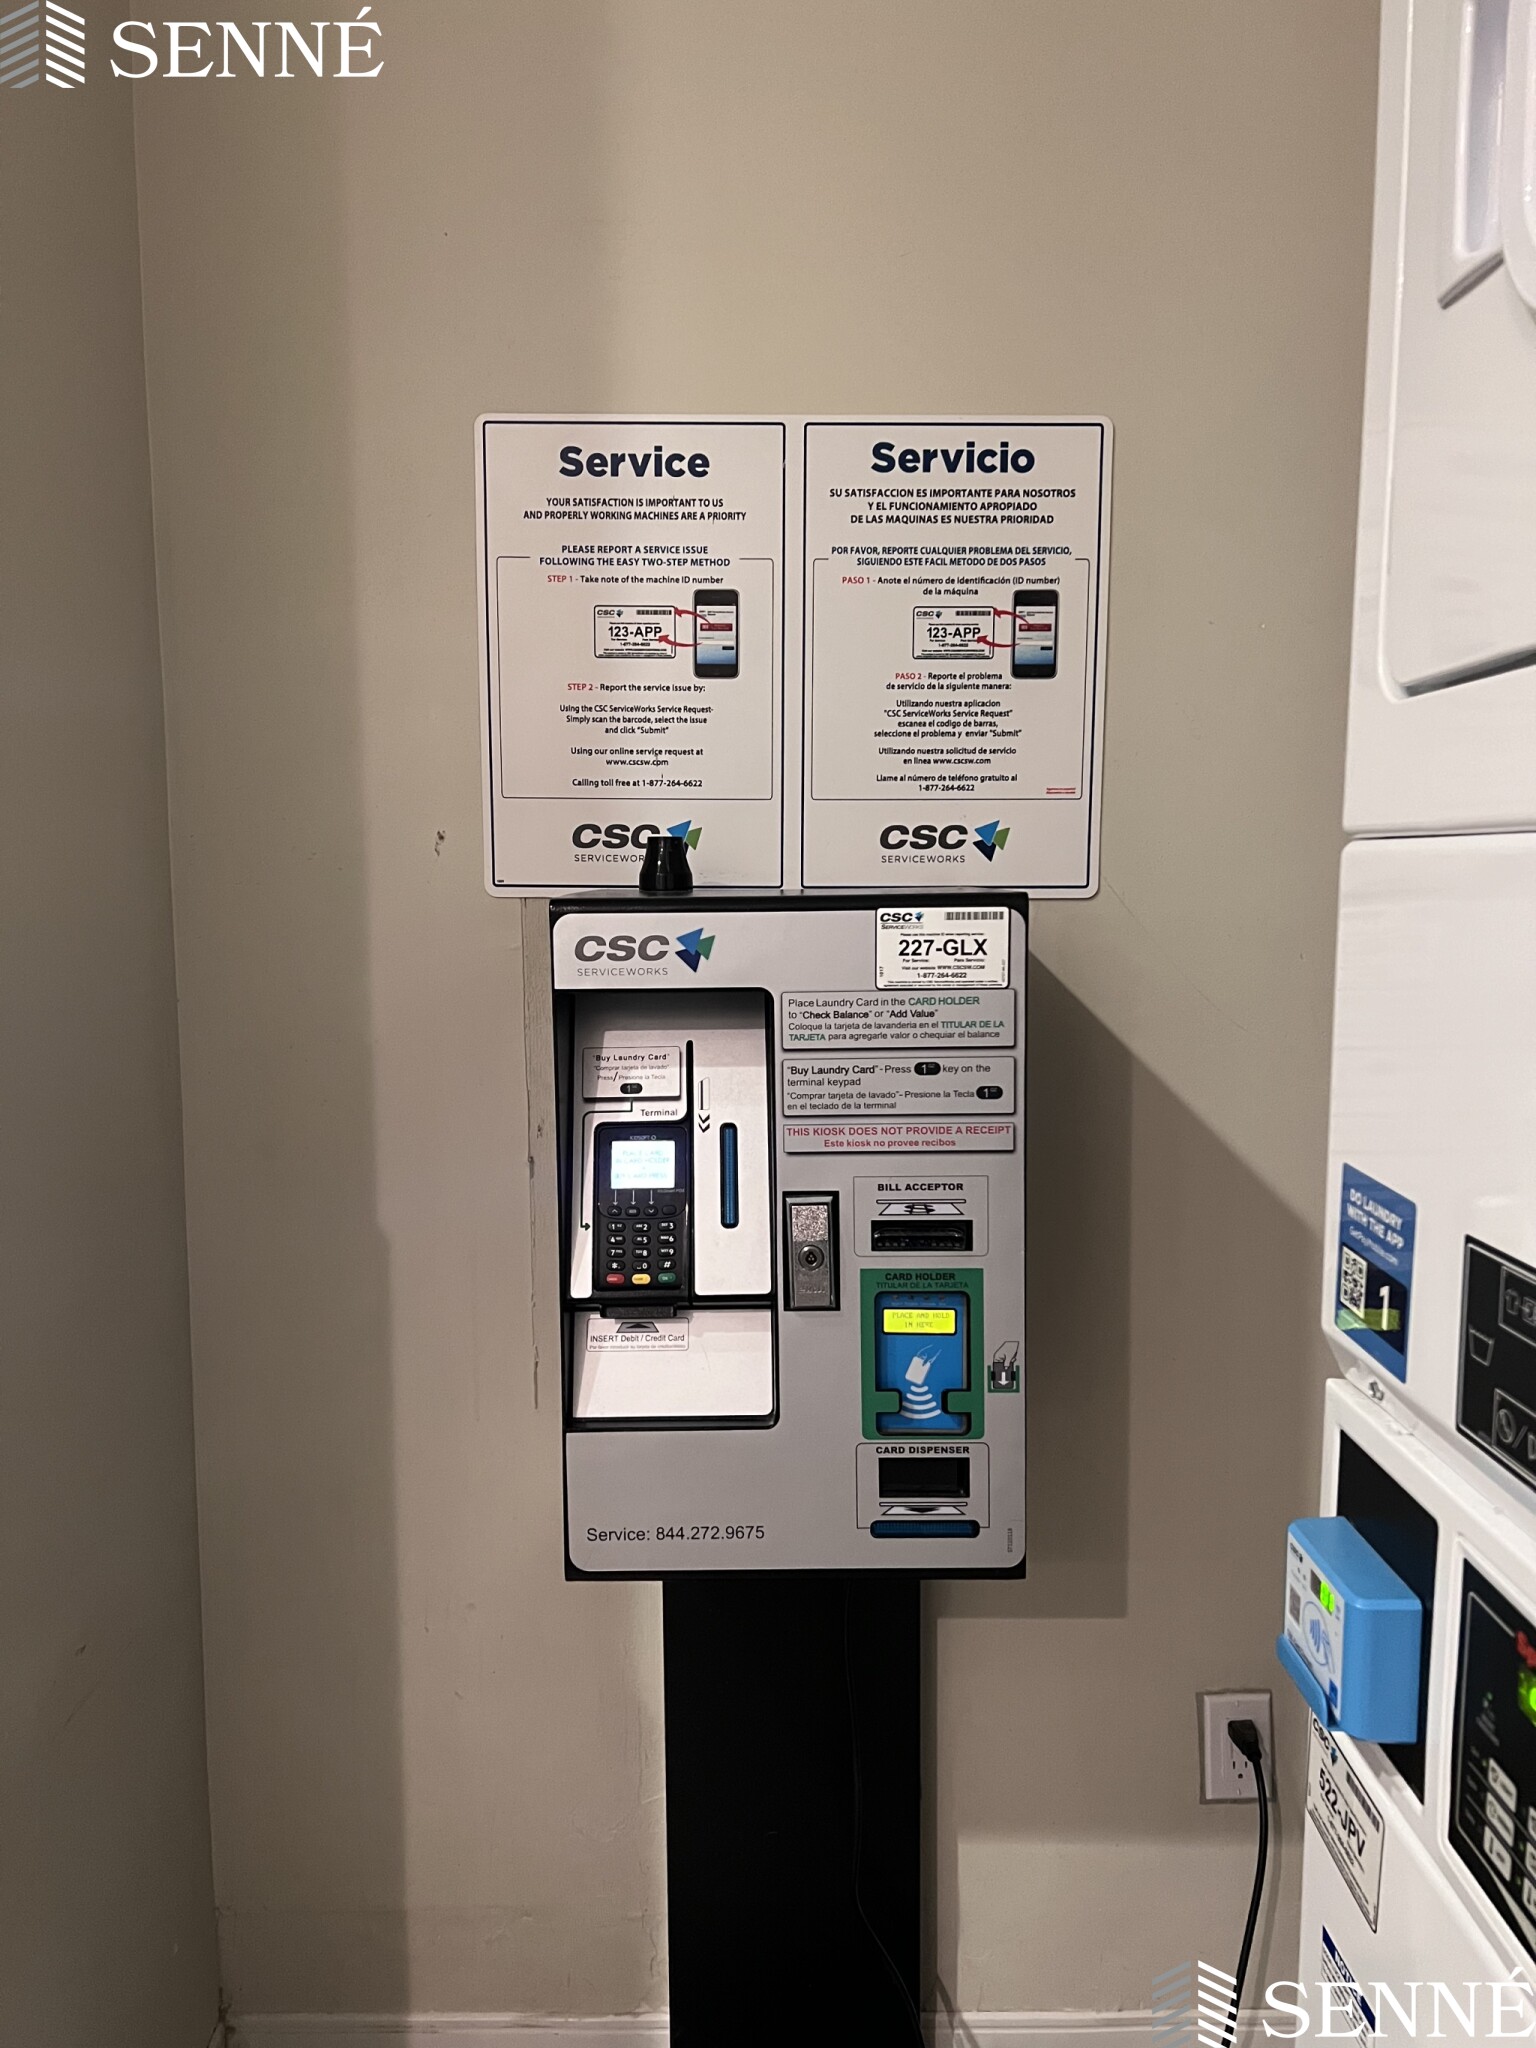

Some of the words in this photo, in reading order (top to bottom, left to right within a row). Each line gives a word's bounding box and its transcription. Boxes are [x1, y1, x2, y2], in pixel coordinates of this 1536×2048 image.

[560, 446, 708, 478] Service
[871, 441, 1034, 473] Servicio
[829, 488, 842, 497] SU
[844, 488, 913, 498] SATISFACCION
[916, 488, 927, 497] ES
[929, 488, 992, 498] IMPORTANTE
[994, 488, 1020, 497] PARA
[1022, 488, 1075, 498] NOSOTROS
[546, 497, 570, 506] YOUR
[572, 497, 633, 507] SATISFACTION
[635, 498, 643, 507] IS
[645, 497, 696, 507] IMPORTANT
[697, 498, 710, 507] TO
[711, 497, 723, 507] US
[867, 502, 874, 510] Y
[876, 502, 887, 510] EL
[889, 502, 977, 510] FUNCIONAMIENTO
[979, 502, 1037, 510] APROPIADO
[523, 510, 542, 519] AND
[544, 510, 588, 519] PROPERLY
[590, 510, 632, 520] WORKING
[633, 511, 679, 520] MACHINES
[680, 511, 697, 520] ARE
[699, 511, 705, 520] A
[707, 511, 746, 521] PRIORITY
[850, 514, 863, 524] DE
[865, 514, 883, 523] LAS
[885, 514, 938, 525] MAQUINAS
[940, 514, 951, 524] ES
[954, 514, 998, 524] NUESTRA
[1000, 514, 1054, 524] PRIORIDAD
[561, 545, 595, 553] PLEASE
[597, 545, 632, 554] REPORT
[634, 545, 641, 554] A
[643, 545, 680, 554] SERVICE
[682, 545, 708, 554] ISSUE
[831, 546, 848, 554] POR
[850, 546, 880, 555] FAVOR,
[881, 546, 918, 555] REPORTE
[919, 546, 966, 555] CUALQUIER
[968, 546, 1013, 555] PROBLEMA
[1014, 546, 1030, 555] DEL
[1032, 546, 1072, 555] SERVICIO,
[539, 557, 594, 565] FOLLOWING
[596, 557, 614, 566] THE
[616, 557, 639, 566] EASY
[641, 557, 688, 566] TWO-STEP
[690, 557, 730, 566] METHOD
[547, 574, 566, 582] STEP
[579, 574, 599, 583] Take
[600, 575, 619, 583] note
[620, 575, 629, 583] of
[630, 575, 644, 583] the
[645, 575, 679, 583] machine
[681, 575, 690, 583] ID
[691, 575, 723, 583] number
[608, 626, 663, 639] 123-APP
[926, 626, 981, 639] 123-APP
[599, 683, 626, 692] Report
[628, 683, 641, 691] the
[643, 683, 670, 691] service
[672, 683, 691, 691] issue
[693, 683, 705, 693] by:
[605, 758, 668, 766] www.cscsw.com
[572, 778, 599, 788] Calling
[600, 778, 613, 786] toll
[615, 778, 630, 786] free
[642, 779, 702, 787] 1-877-264-6622
[879, 824, 968, 850] CSC
[881, 854, 965, 863] SERVICEWORKS
[880, 912, 912, 923] CSC
[574, 934, 669, 962] CSC
[898, 938, 987, 956] 227-GLX
[576, 967, 668, 977] SERVICEWORKS
[788, 998, 814, 1007] Place
[815, 997, 854, 1008] Laundry
[855, 997, 878, 1006] Card
[880, 997, 888, 1006] in
[890, 997, 905, 1005] the
[908, 997, 936, 1005] CARD
[938, 997, 979, 1005] HOLDER
[788, 1010, 797, 1019] to
[799, 1010, 831, 1019] "Check
[833, 1010, 872, 1018] Balance"
[886, 1009, 907, 1018] "Add
[909, 1009, 938, 1017] Value"
[592, 1054, 610, 1062] "Buy
[786, 1066, 809, 1076] "Buy
[811, 1065, 849, 1076] Laundry
[852, 1065, 878, 1074] Card"
[884, 1065, 911, 1073] Press
[942, 1064, 959, 1074] key
[975, 1064, 990, 1072] the
[787, 1077, 824, 1087] terminal
[827, 1077, 861, 1088] keypad
[640, 1108, 677, 1116] Terminal
[786, 1127, 809, 1136] THIS
[813, 1127, 845, 1136] KIOSK
[848, 1127, 877, 1135] DOES
[880, 1127, 903, 1135] NOT
[905, 1126, 952, 1135] PROVIDE
[954, 1126, 963, 1134] A
[965, 1126, 1011, 1135] RECEIPT
[824, 1139, 844, 1147] Este
[846, 1139, 871, 1147] kiosk
[887, 1140, 919, 1148] provee
[877, 1183, 901, 1191] BILL
[904, 1182, 963, 1191] ACCEPTOR
[1349, 1188, 1362, 1205] DO
[1363, 1196, 1403, 1231] LAUNDRY
[1346, 1203, 1368, 1227] WITH
[1369, 1217, 1385, 1239] THE
[1385, 1230, 1405, 1249] APP
[885, 1272, 912, 1281] CARD
[915, 1272, 955, 1281] HOLDER
[1379, 1285, 1390, 1331] 1
[620, 1334, 639, 1342] Debit
[875, 1446, 905, 1454] CARD
[908, 1446, 969, 1454] DISPENSER
[586, 1528, 650, 1541] Service:
[655, 1527, 764, 1542] 844.272.9675
[1318, 1768, 1366, 1857] 522-JPV
